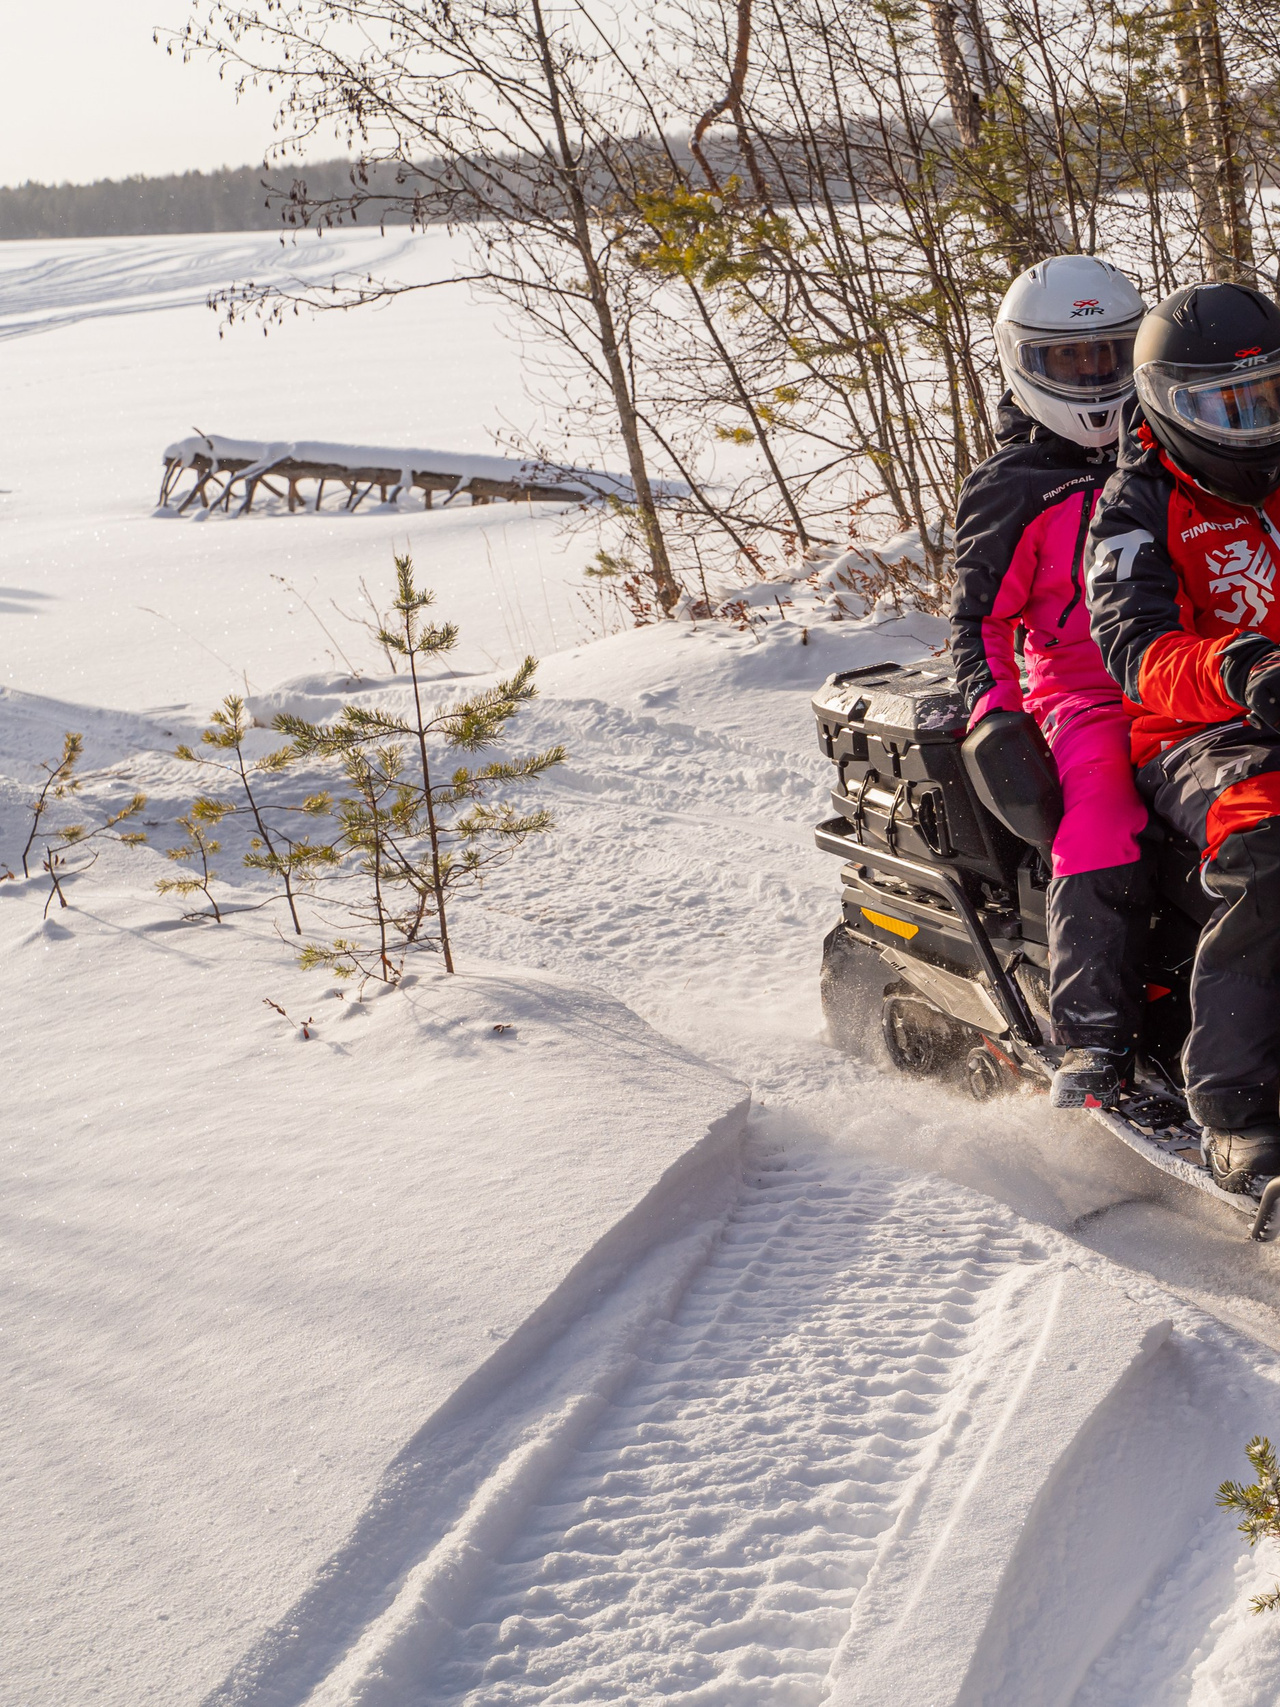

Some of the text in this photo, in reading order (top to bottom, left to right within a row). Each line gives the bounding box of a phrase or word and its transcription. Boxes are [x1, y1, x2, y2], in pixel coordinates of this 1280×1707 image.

[1070, 306, 1105, 319] XTR
[1232, 355, 1268, 371] XTR
[1042, 475, 1095, 501] FINNTRAIL
